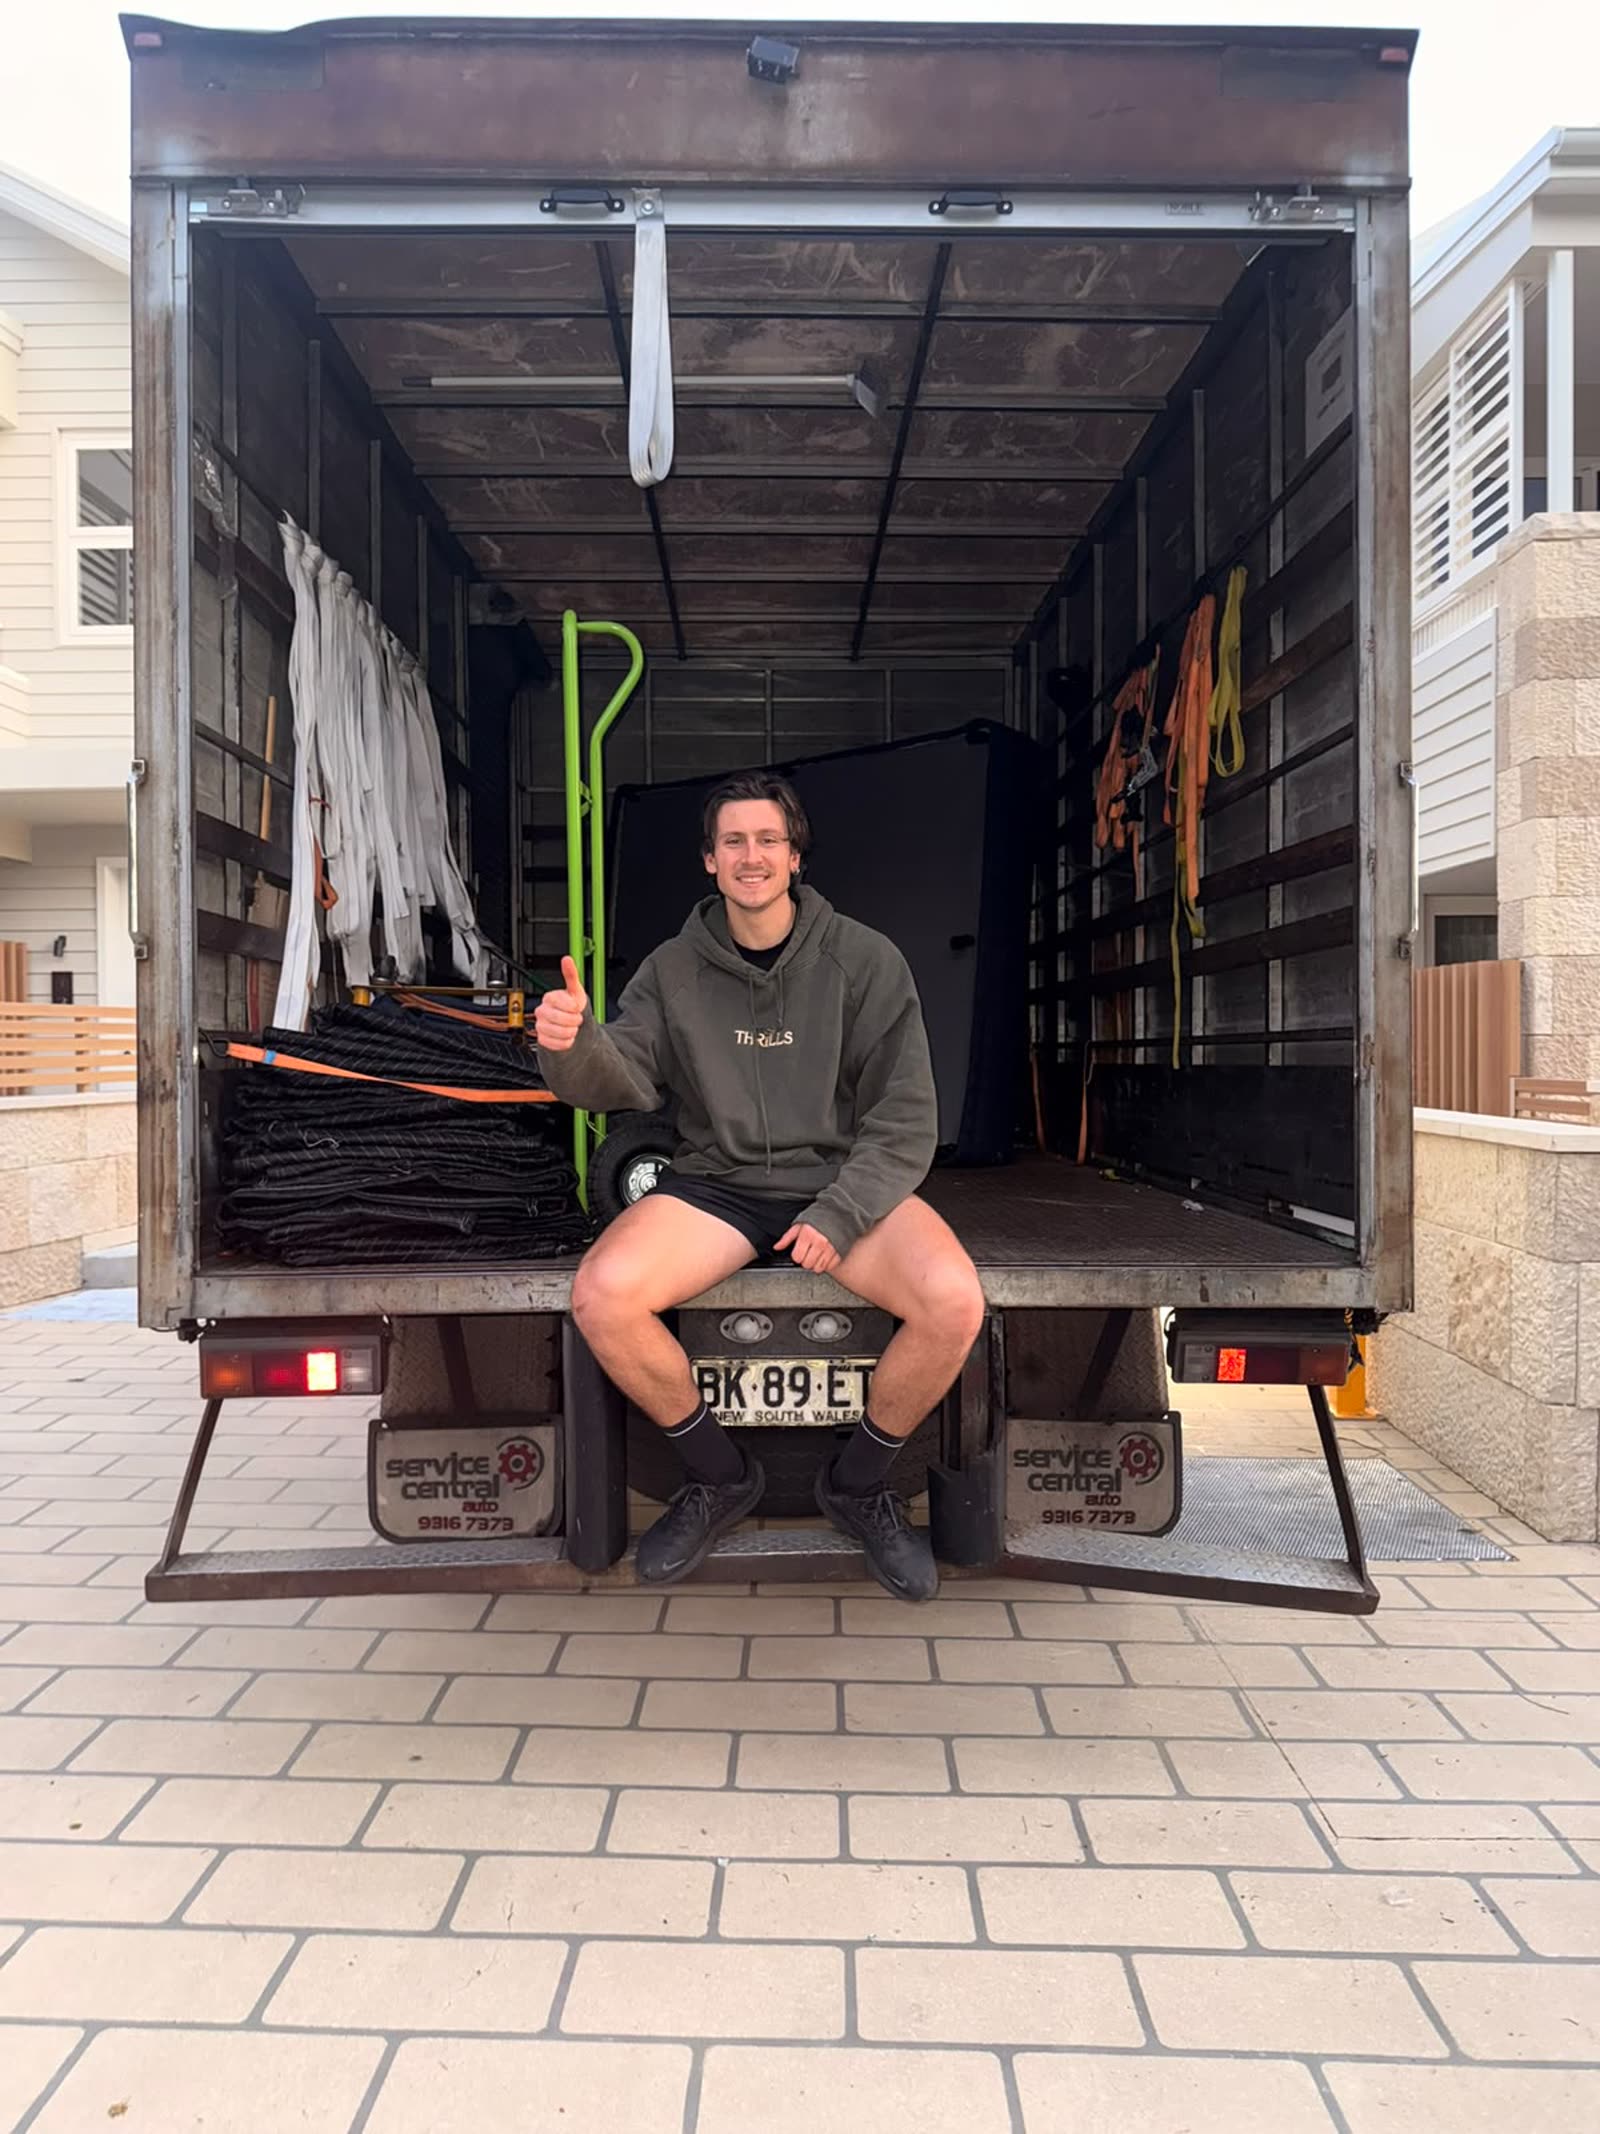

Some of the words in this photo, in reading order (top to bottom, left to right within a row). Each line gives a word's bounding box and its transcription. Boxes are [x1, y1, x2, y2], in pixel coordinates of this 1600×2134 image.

[734, 1029, 794, 1048] THRILLS
[762, 1365, 811, 1408] 89
[713, 1410, 745, 1422] NEW
[754, 1410, 805, 1422] SOUTH
[812, 1409, 860, 1421] WALES
[385, 1452, 490, 1480] service
[1013, 1445, 1112, 1470] service
[401, 1475, 500, 1500] central
[1027, 1468, 1122, 1492] central
[462, 1499, 499, 1513] auto
[1084, 1492, 1122, 1506] auto
[418, 1516, 461, 1530] 9316
[465, 1517, 514, 1531] 7373
[1041, 1510, 1084, 1524] 9316
[1088, 1510, 1137, 1525] 7373
